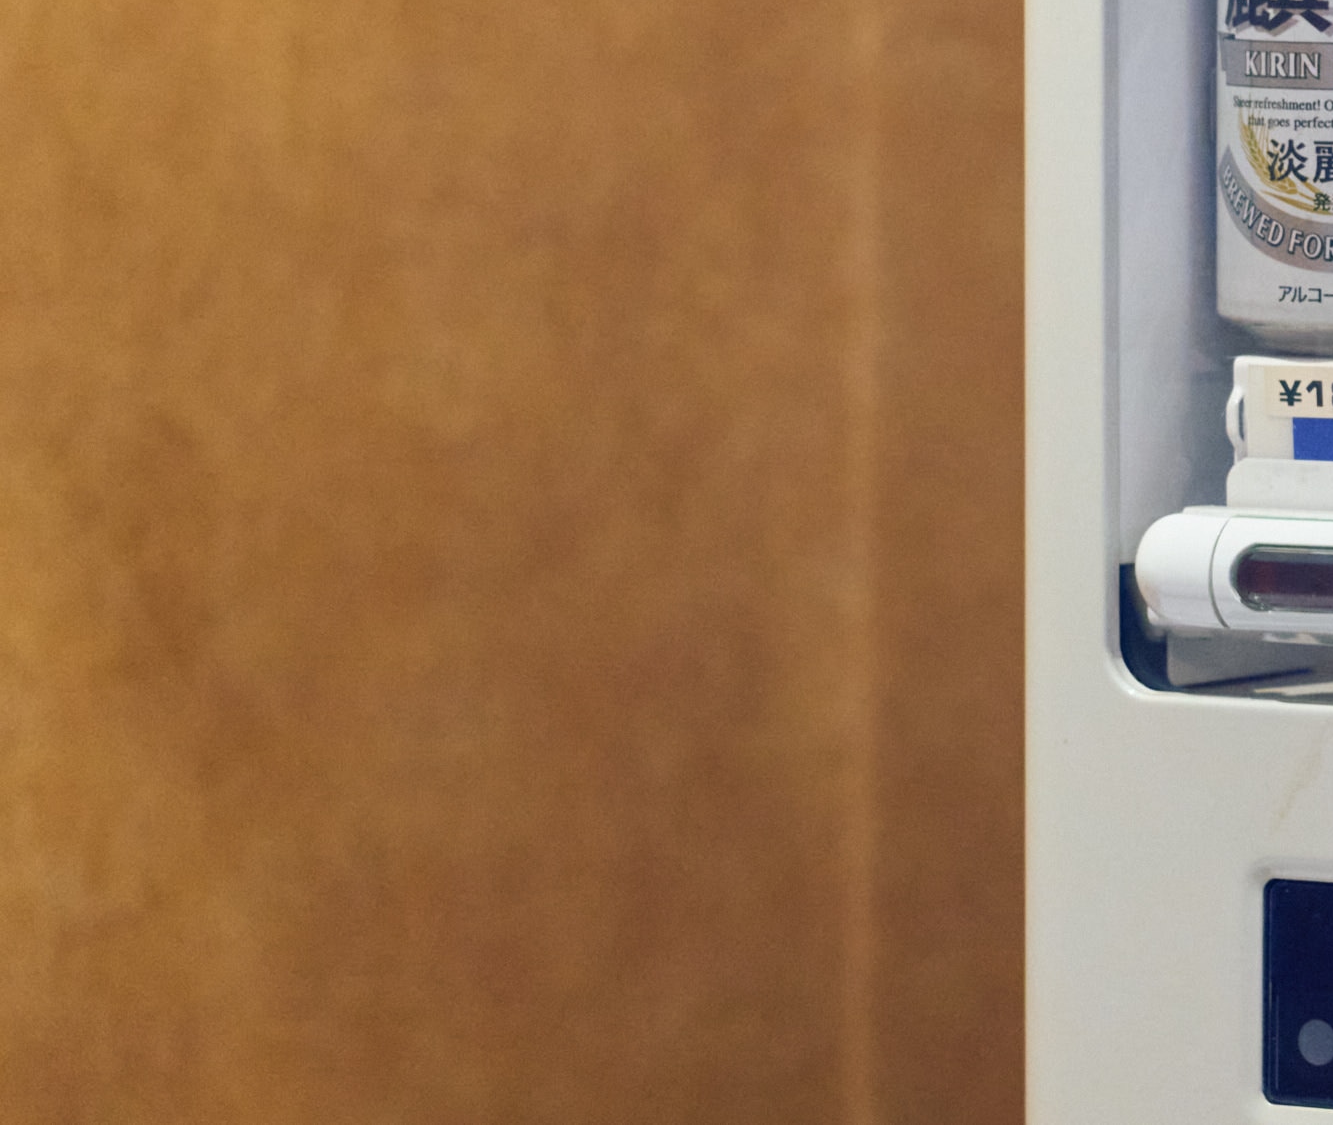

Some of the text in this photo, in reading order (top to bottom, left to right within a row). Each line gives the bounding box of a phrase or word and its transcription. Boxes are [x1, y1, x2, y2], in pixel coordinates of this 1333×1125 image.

[1244, 50, 1321, 78] KIRIN
[1254, 97, 1320, 111] refreshment!
[1248, 114, 1264, 126] that
[1267, 118, 1290, 130] goes
[1223, 166, 1285, 252] BREWED
